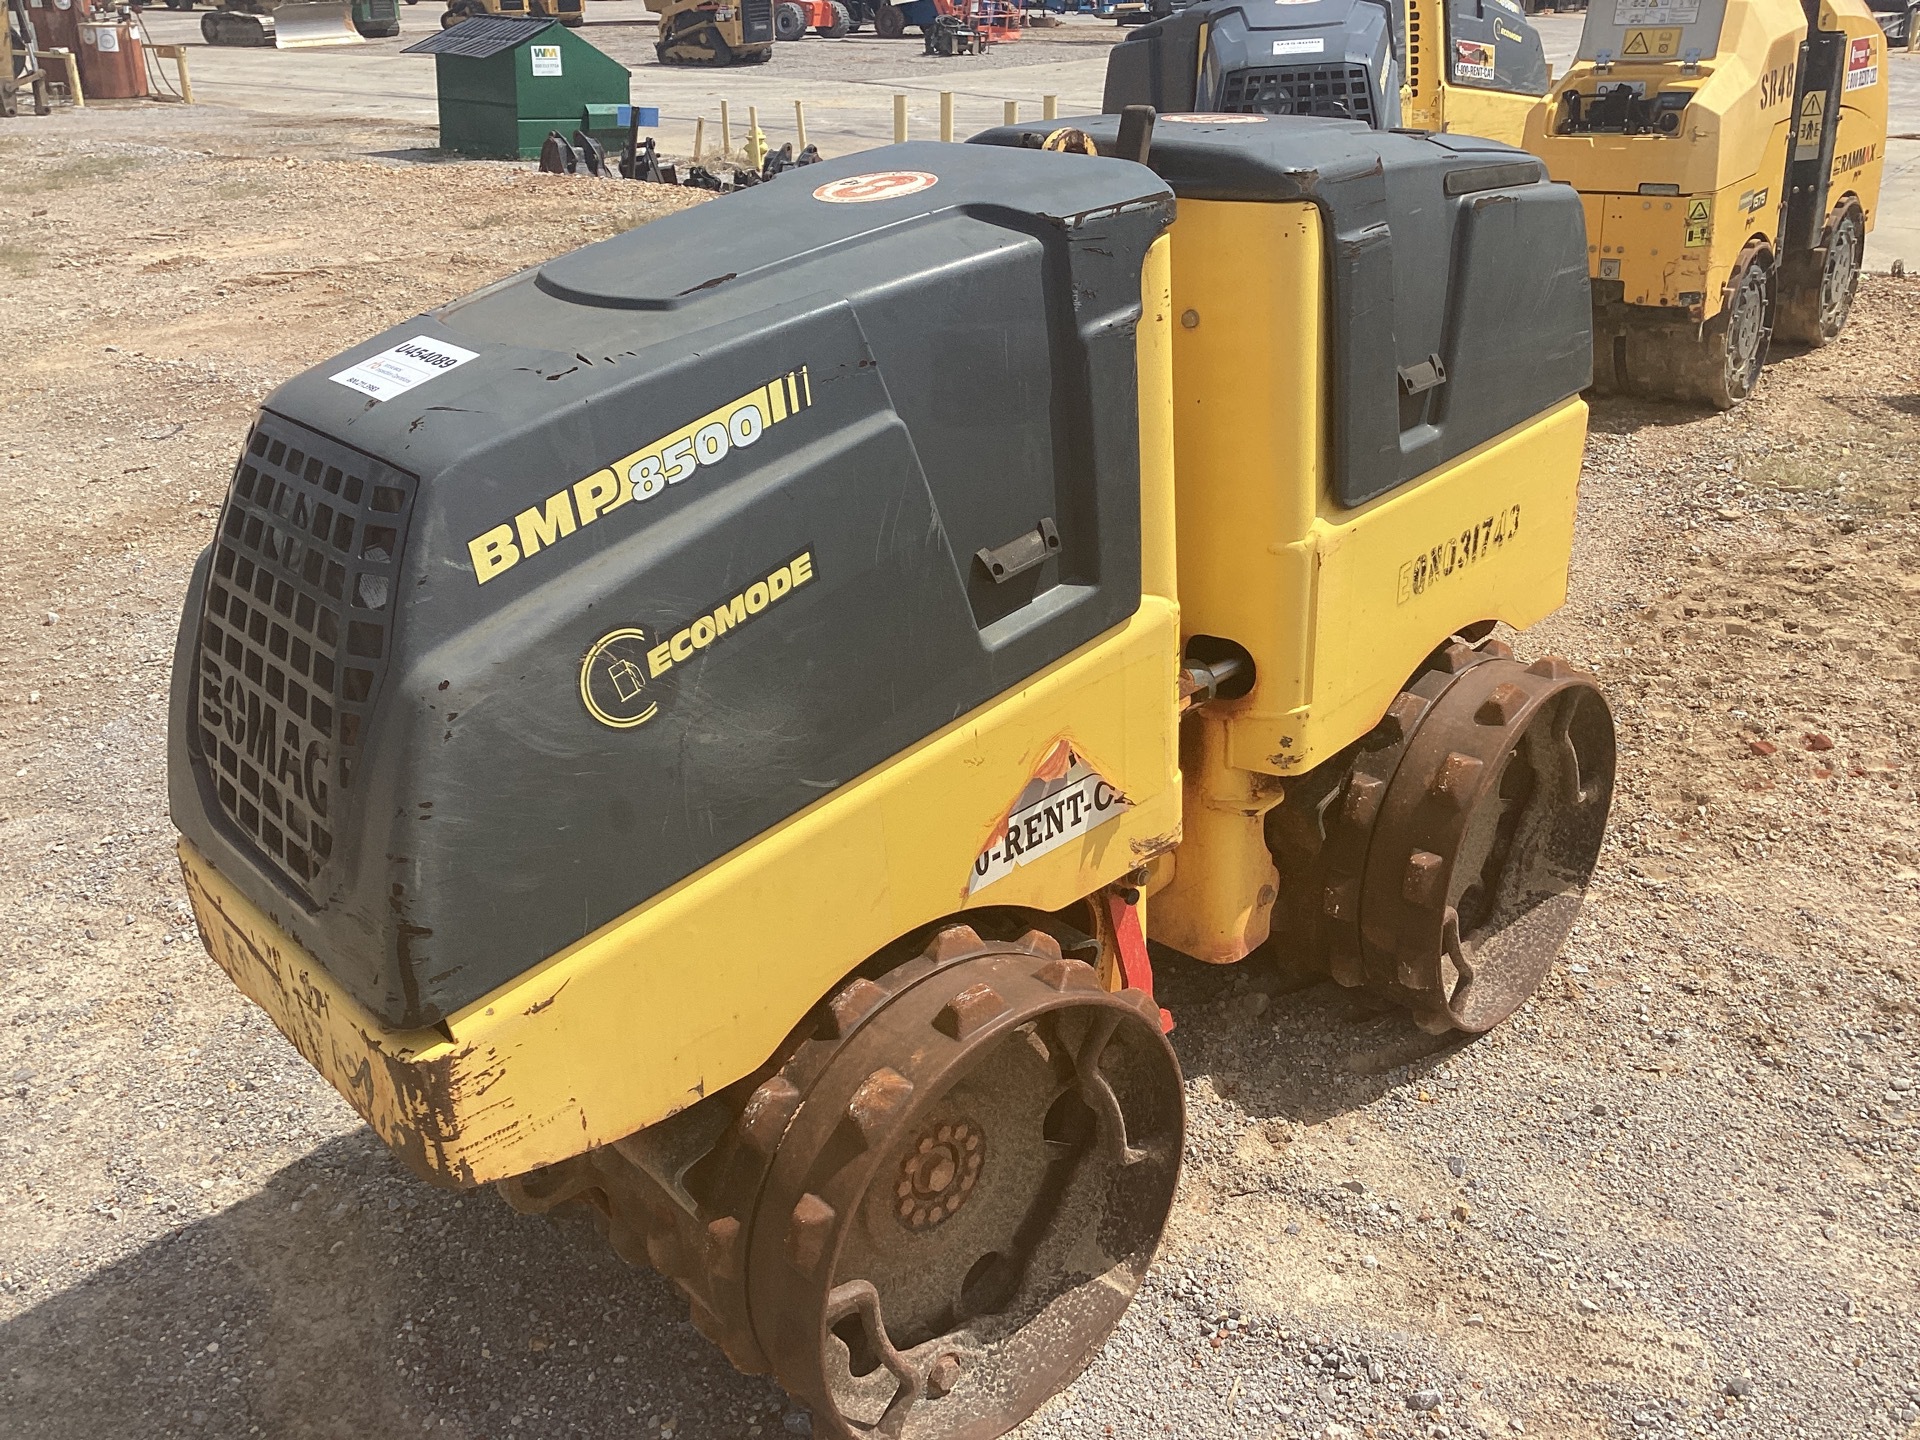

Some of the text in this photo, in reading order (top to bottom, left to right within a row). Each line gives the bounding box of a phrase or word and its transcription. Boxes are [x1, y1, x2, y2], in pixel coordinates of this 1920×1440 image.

[534, 48, 556, 57] WM
[1761, 63, 1794, 110] SR48
[395, 344, 458, 368] U454089
[468, 466, 622, 585] BMP
[628, 404, 763, 503] 8500
[647, 551, 813, 679] ECOMODE
[201, 657, 329, 818] BOMAG
